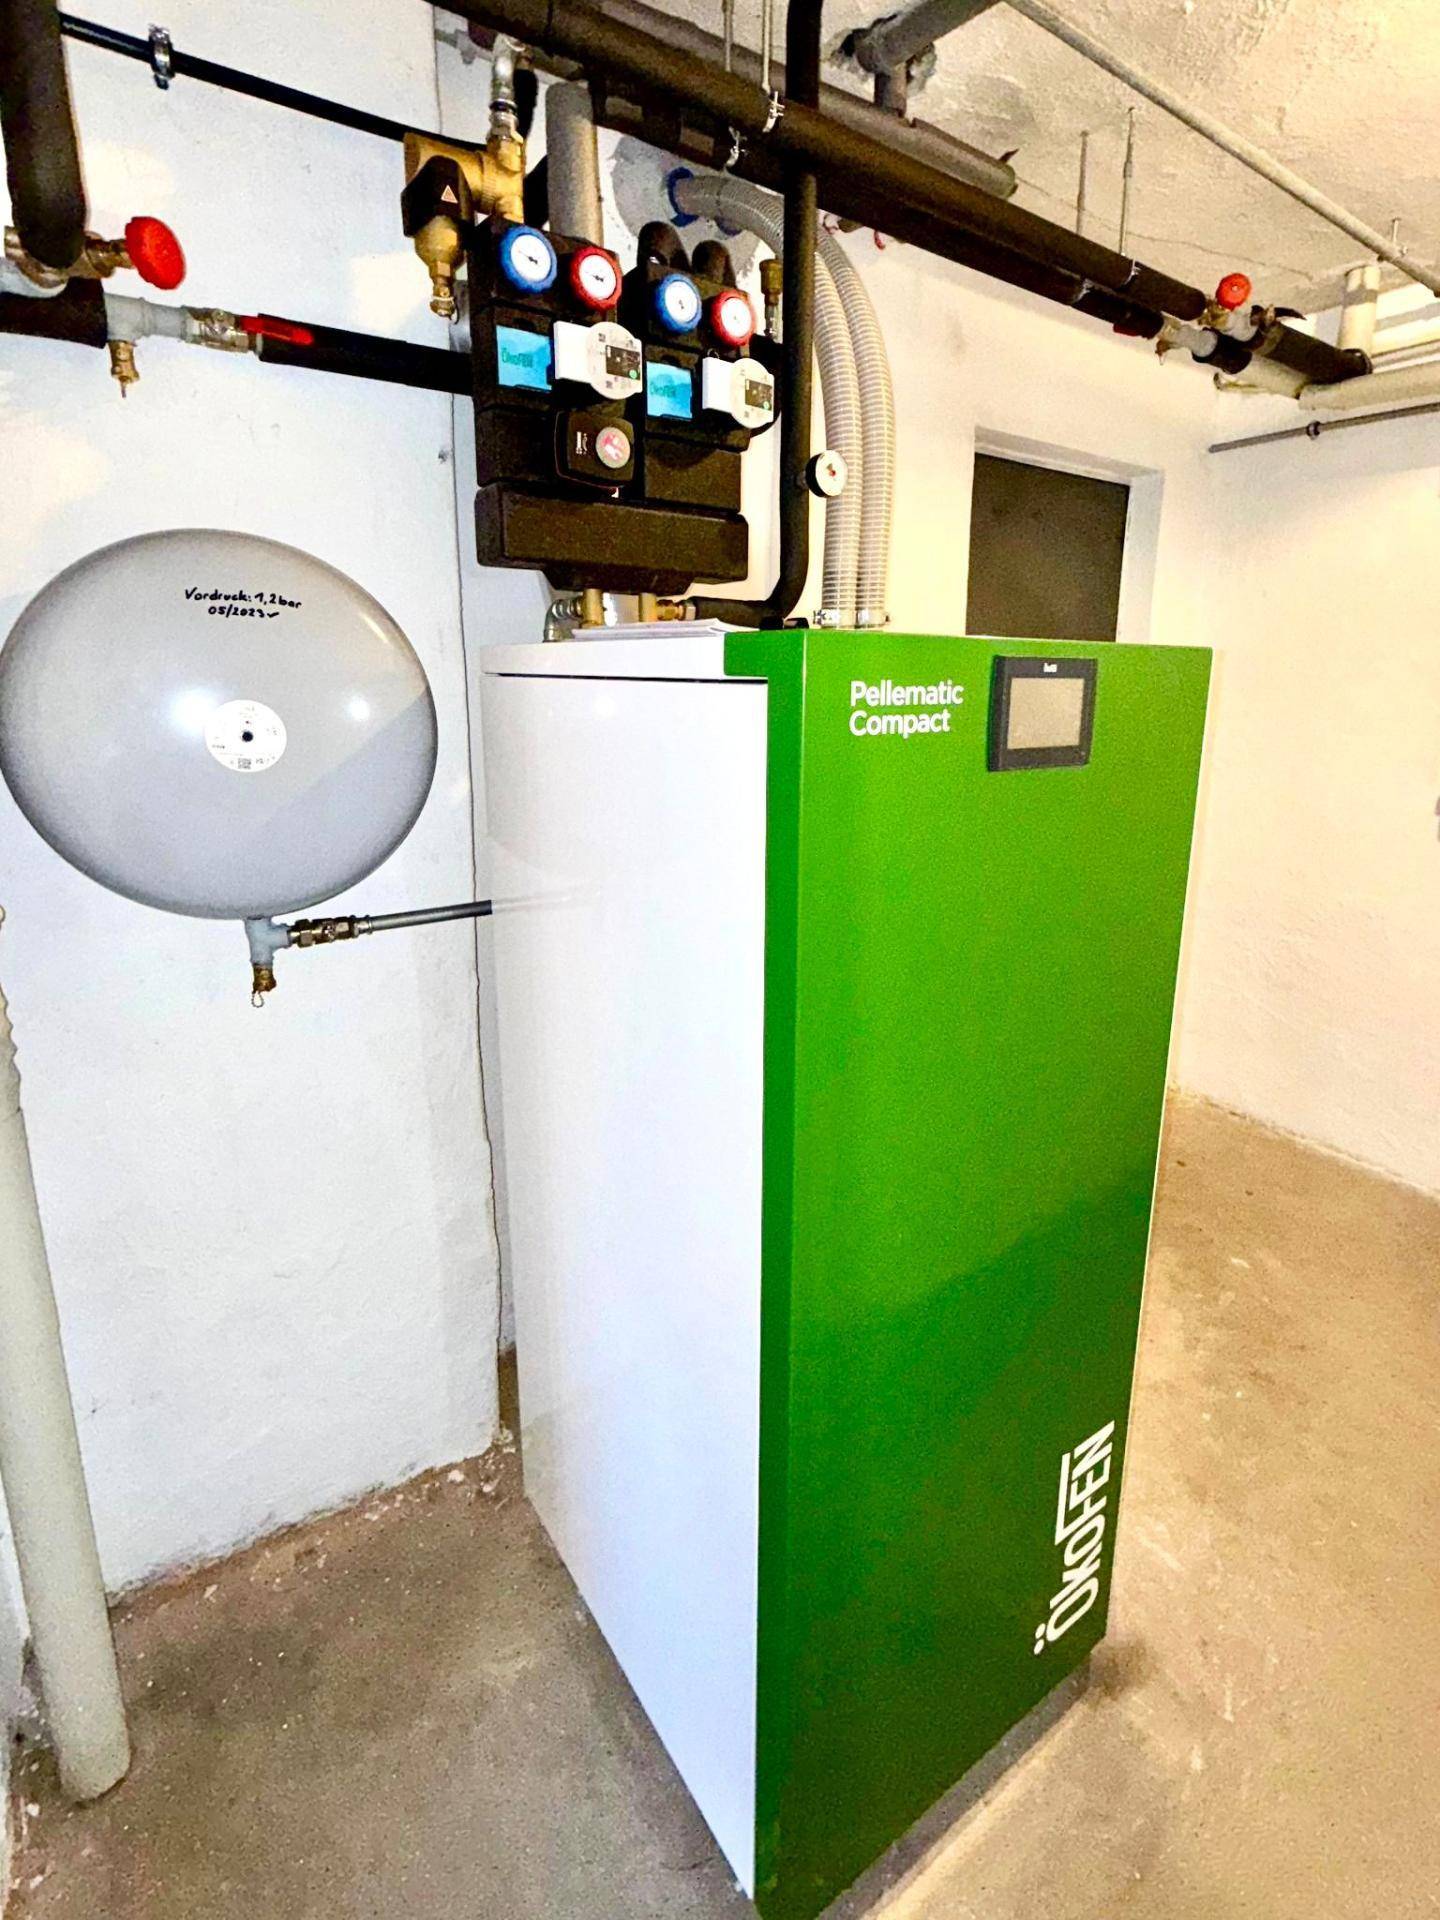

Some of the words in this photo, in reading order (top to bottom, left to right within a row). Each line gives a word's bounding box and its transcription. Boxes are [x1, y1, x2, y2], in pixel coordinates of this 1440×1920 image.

[184, 586, 252, 602] Vordruck:
[207, 603, 265, 618] 05/2023
[850, 678, 964, 707] Pellematic
[848, 708, 951, 739] Compact
